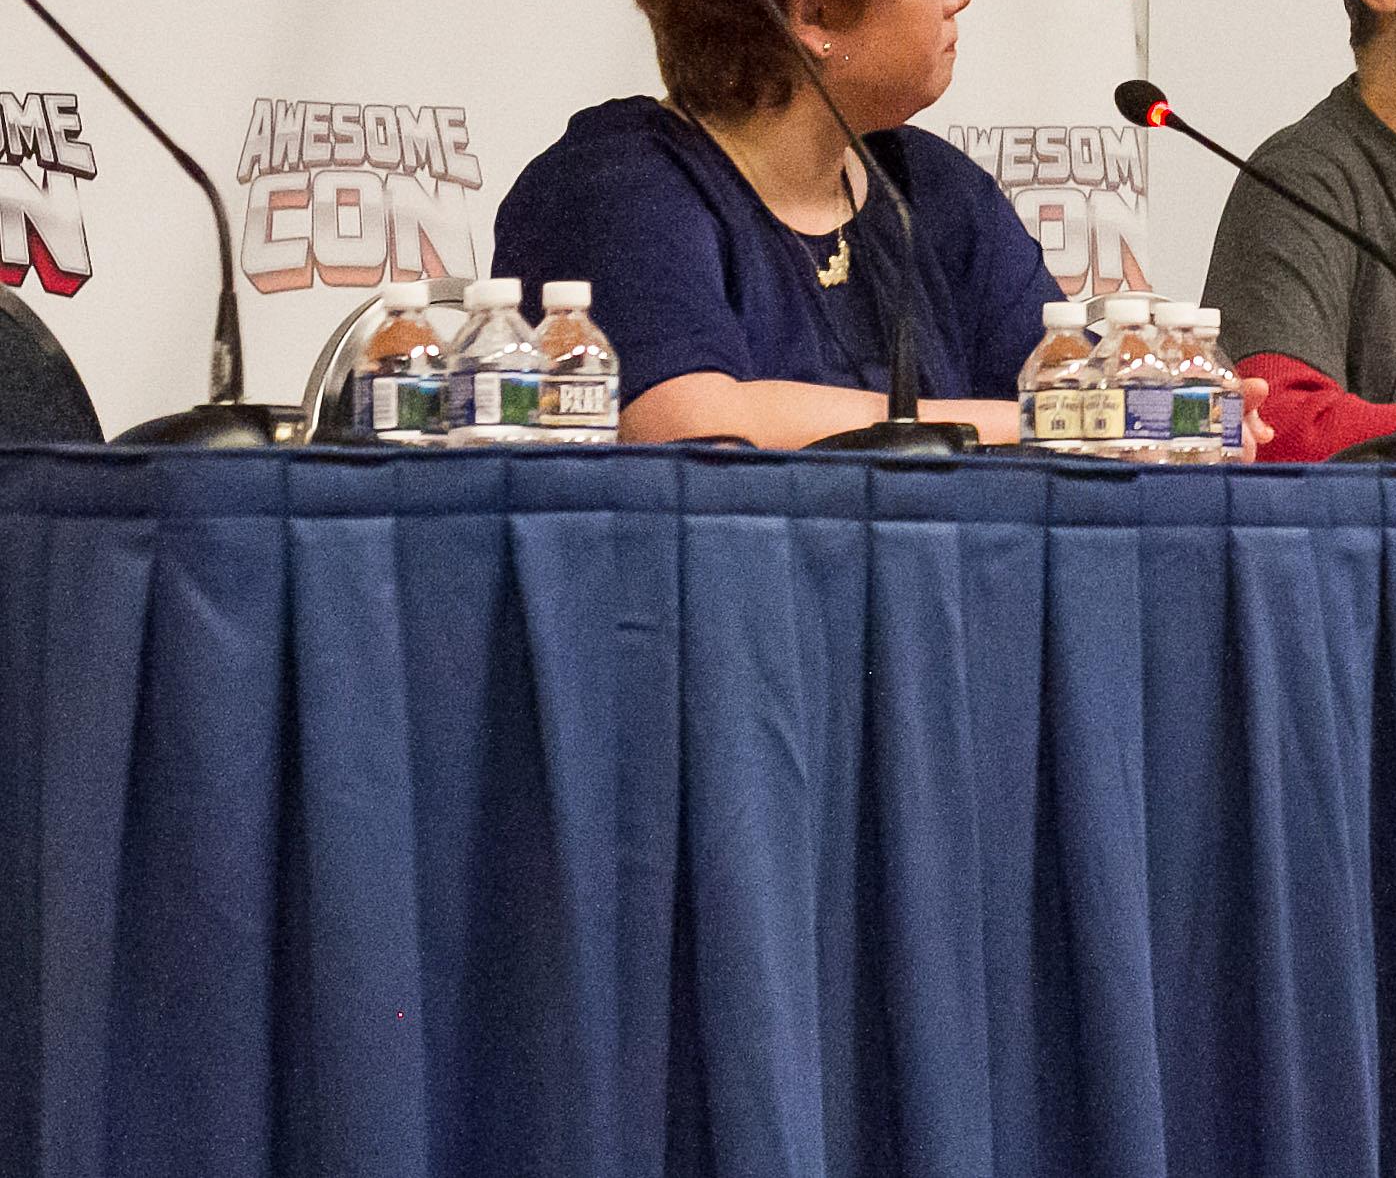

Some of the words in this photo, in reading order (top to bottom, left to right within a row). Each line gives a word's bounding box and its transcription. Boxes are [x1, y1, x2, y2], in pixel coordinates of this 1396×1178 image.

[236, 98, 482, 189] AWESOME
[241, 170, 478, 295] CON
[1009, 188, 1153, 297] ON
